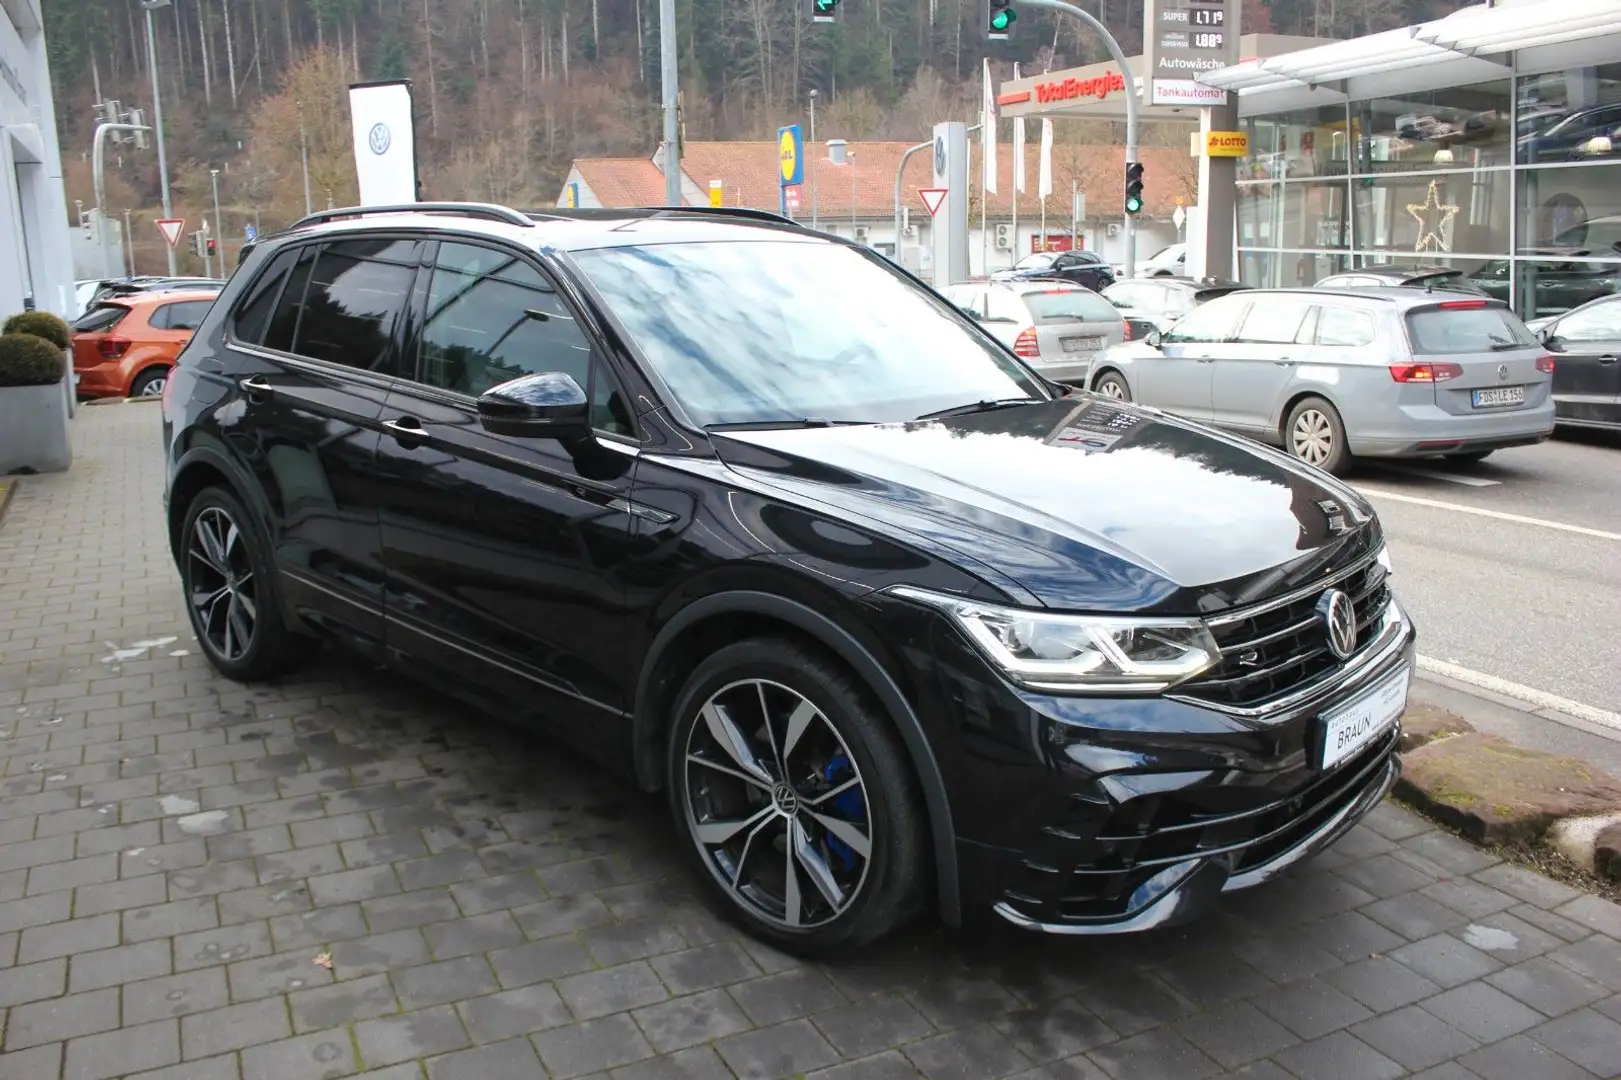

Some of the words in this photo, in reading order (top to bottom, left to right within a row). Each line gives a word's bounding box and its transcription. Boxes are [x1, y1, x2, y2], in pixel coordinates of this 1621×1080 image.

[1162, 11, 1188, 21] SUPER
[1159, 56, 1225, 69] Autowäsche
[1157, 86, 1225, 99] Tankautomat
[1220, 136, 1247, 147] LOTTO
[1337, 711, 1372, 750] BRAUN
